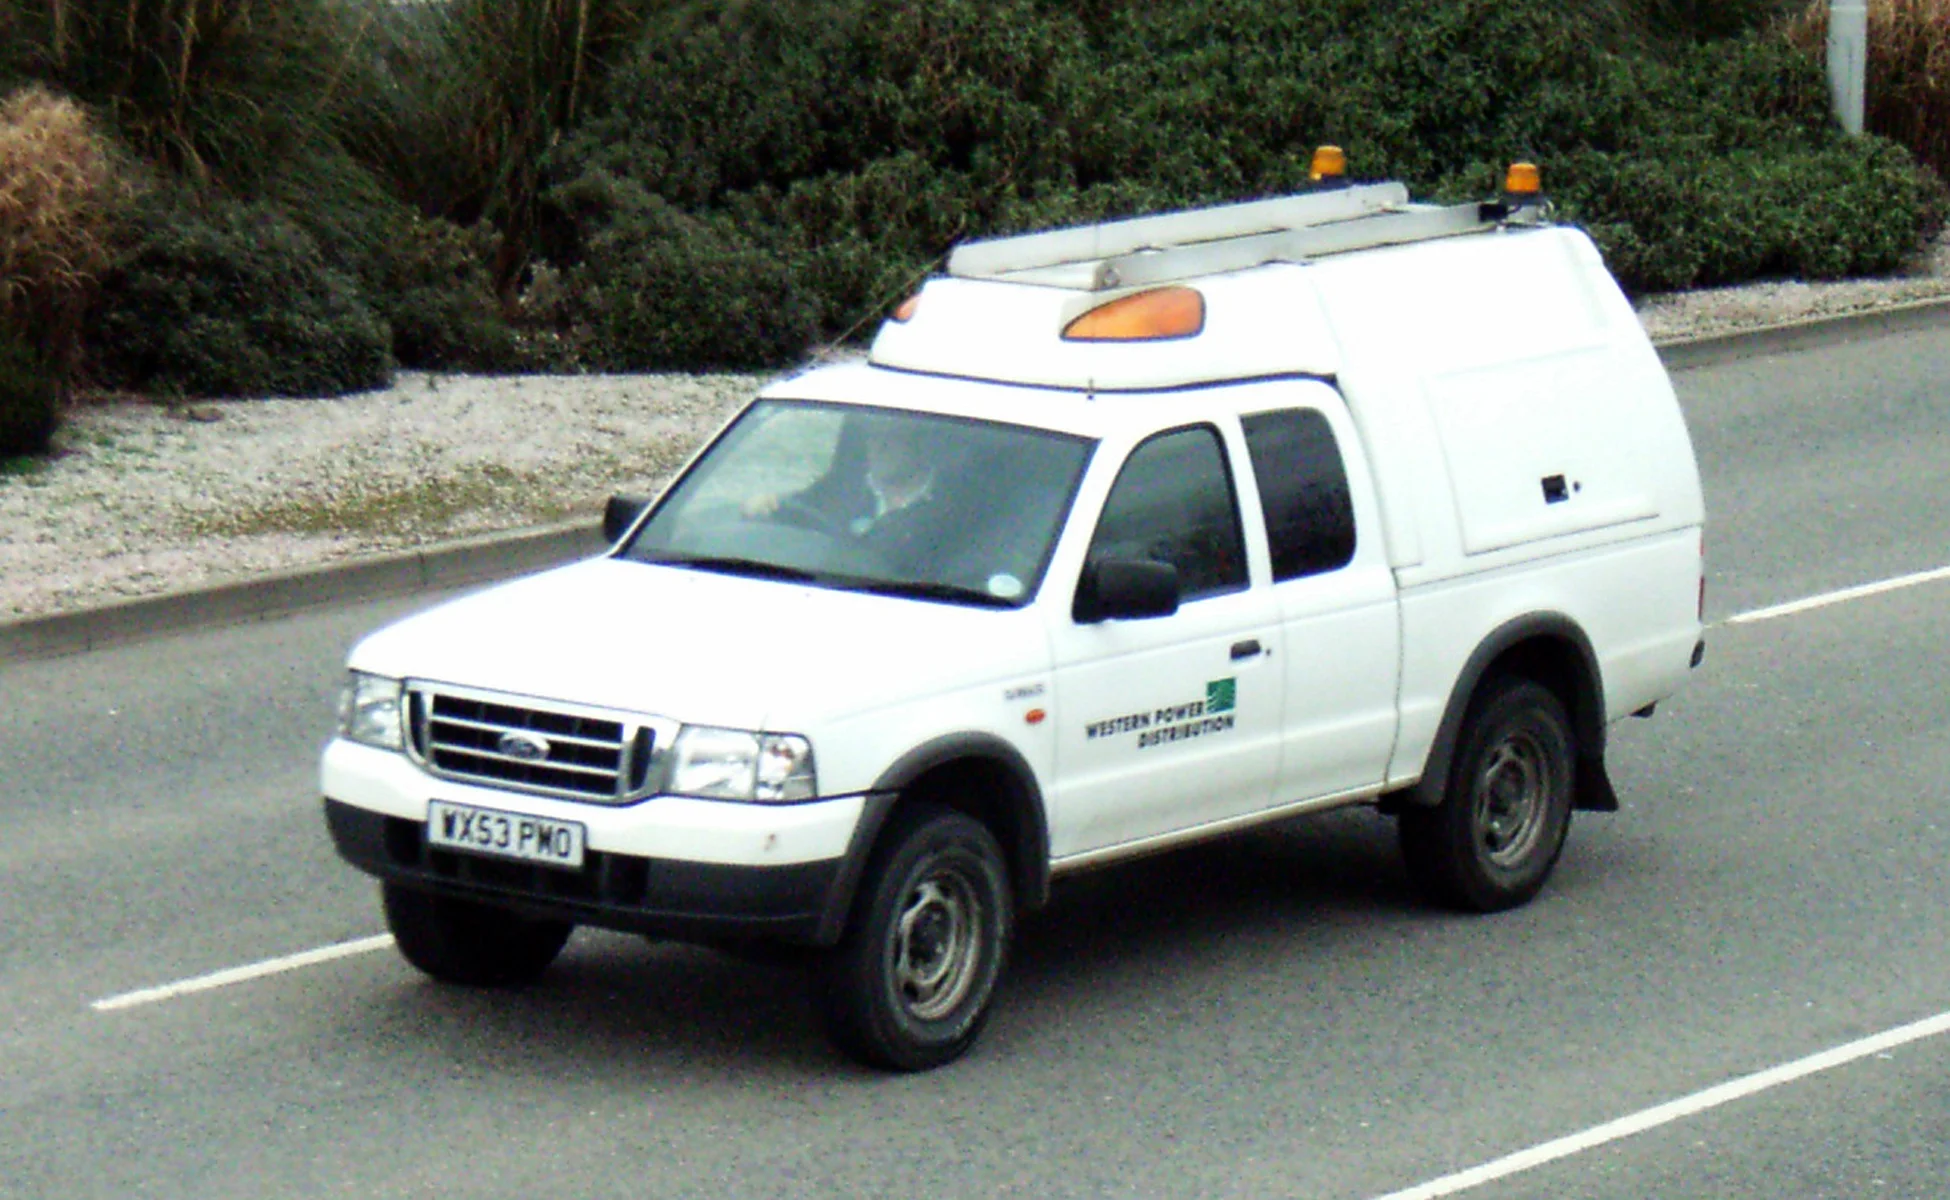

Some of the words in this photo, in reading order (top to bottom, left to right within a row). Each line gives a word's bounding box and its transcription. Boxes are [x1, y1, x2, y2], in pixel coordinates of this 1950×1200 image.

[1086, 713, 1151, 739] WESTERN
[1156, 701, 1205, 725] POWER
[1138, 715, 1235, 749] DISTRIBUTION
[442, 808, 510, 847] WX53
